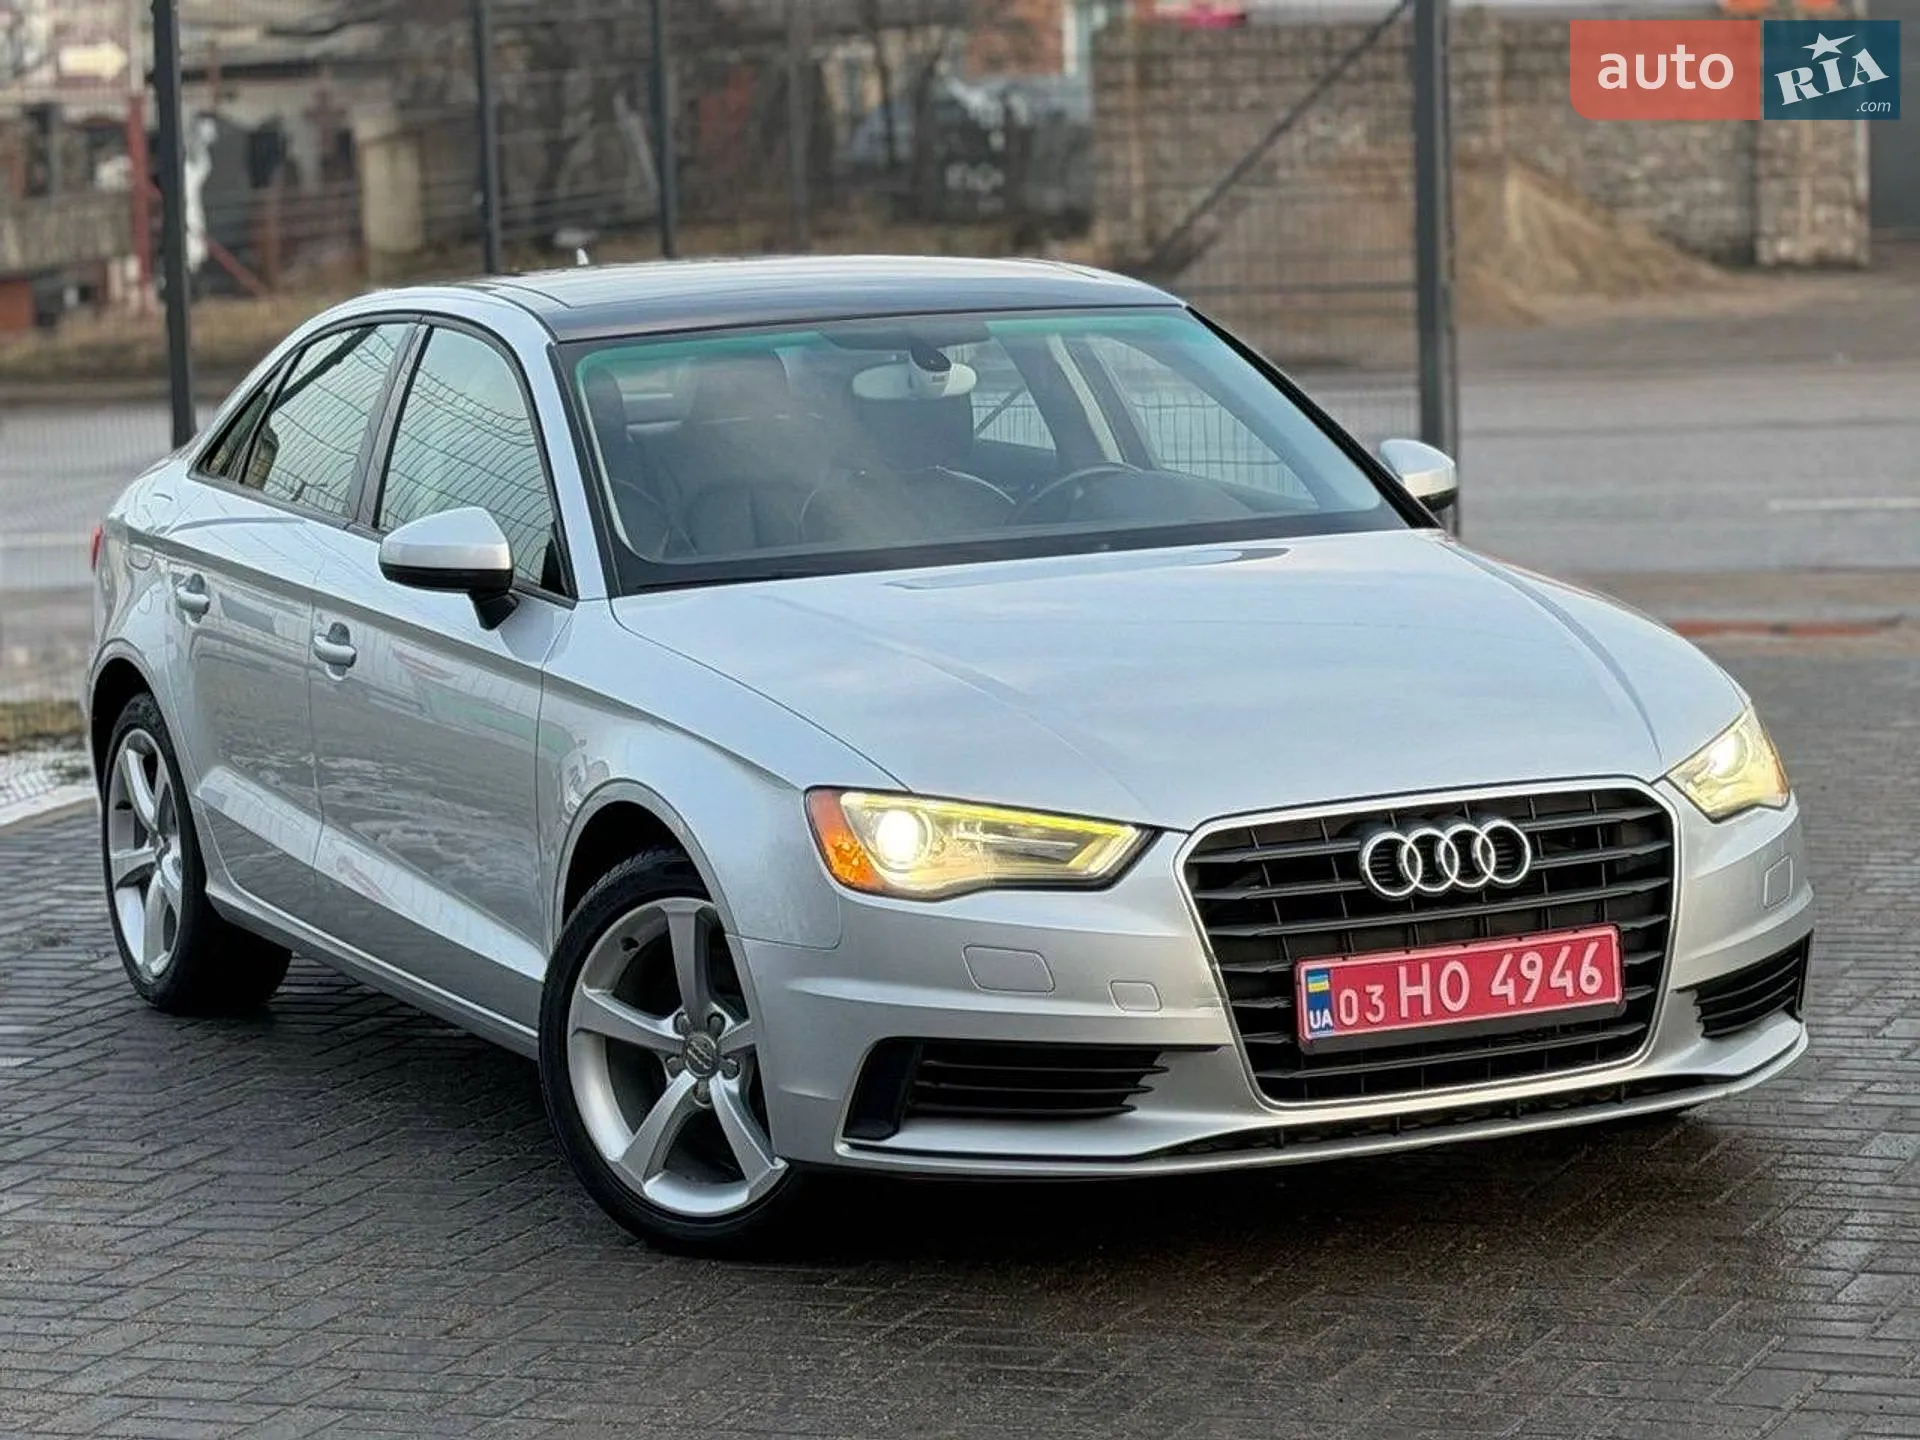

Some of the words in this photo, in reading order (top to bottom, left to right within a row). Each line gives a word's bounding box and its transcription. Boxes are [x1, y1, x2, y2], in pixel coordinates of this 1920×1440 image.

[1339, 984, 1386, 1026] 03
[1398, 960, 1471, 1018] HO
[1490, 941, 1603, 1006] 4946
[1309, 1009, 1334, 1030] UA
